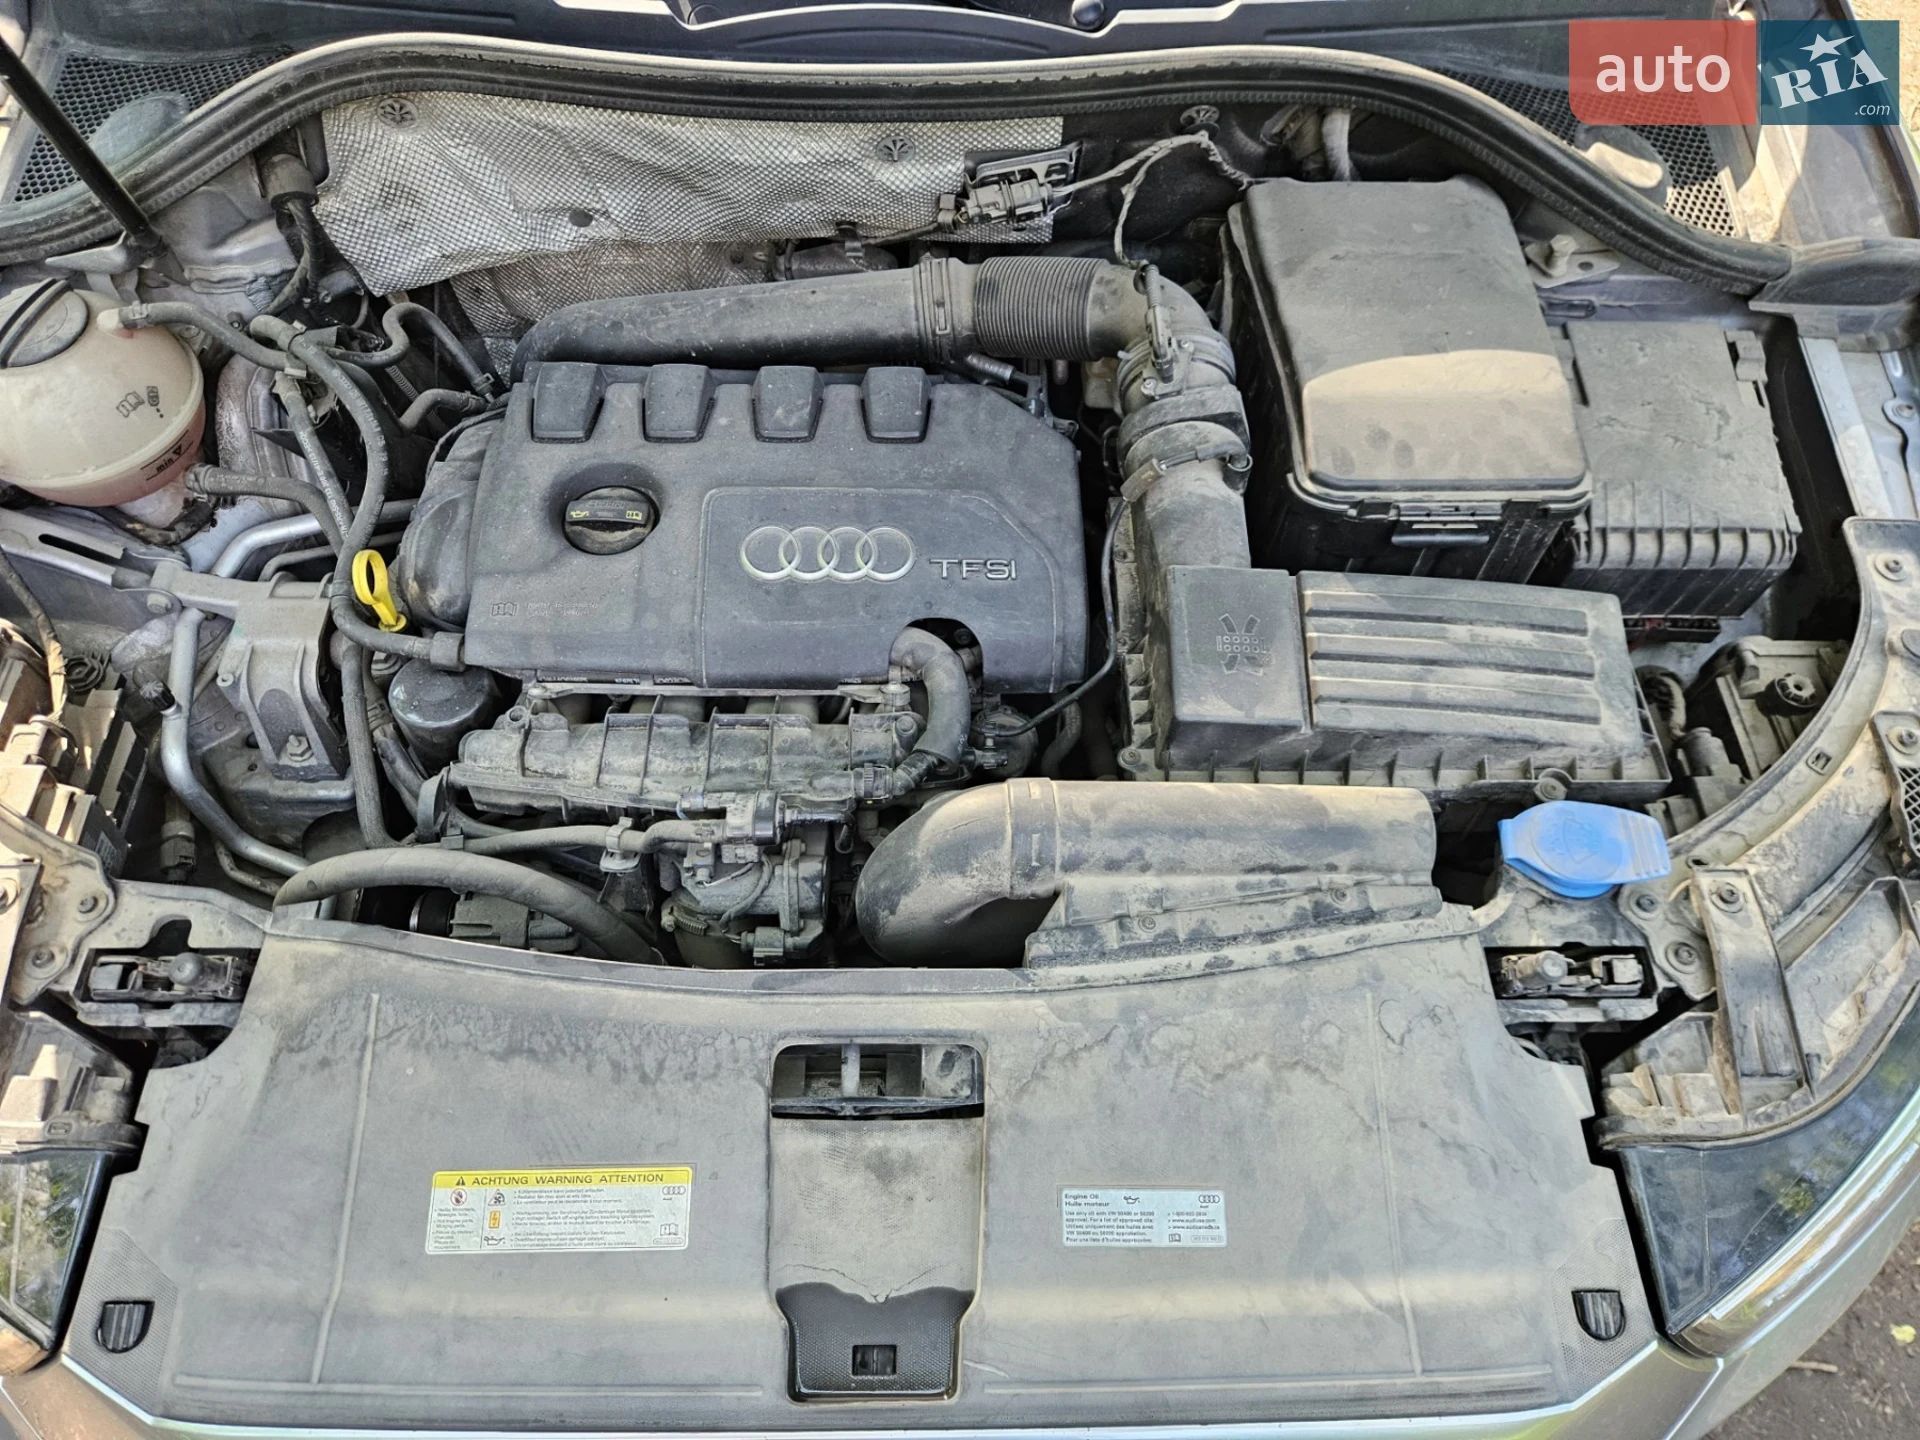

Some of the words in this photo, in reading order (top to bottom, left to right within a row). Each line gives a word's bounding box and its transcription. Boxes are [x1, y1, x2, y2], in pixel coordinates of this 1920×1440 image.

[156, 457, 174, 473] min
[930, 558, 1017, 580] TFSI
[472, 1176, 529, 1186] ACHTUNG
[535, 1174, 593, 1184] WARNING
[600, 1173, 664, 1183] ATTENTION
